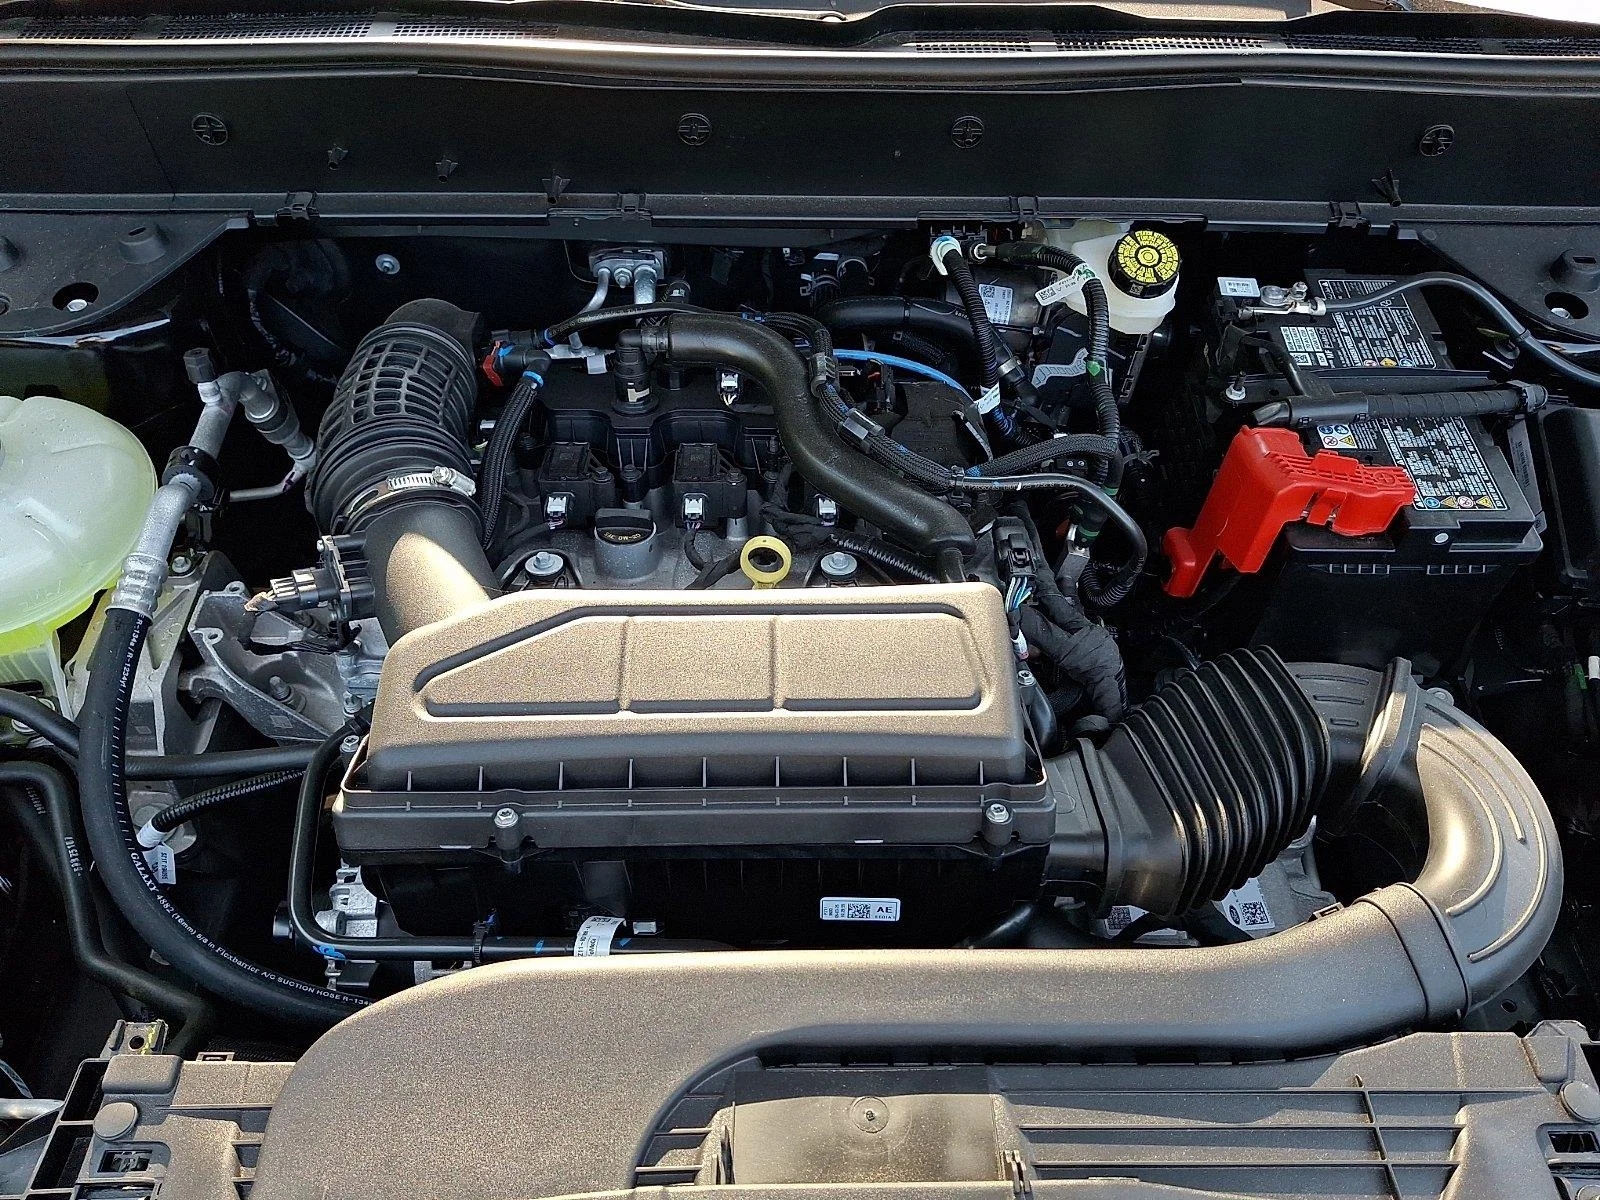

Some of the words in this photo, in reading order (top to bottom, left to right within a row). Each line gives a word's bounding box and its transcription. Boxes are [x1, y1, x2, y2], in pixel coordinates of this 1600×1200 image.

[130, 852, 159, 892] GALAXY
[156, 894, 174, 914] 4882
[215, 946, 260, 974] Flexbarrier
[261, 970, 276, 980] A/C
[277, 977, 315, 994] SUCTION
[316, 990, 340, 1000] HOSE
